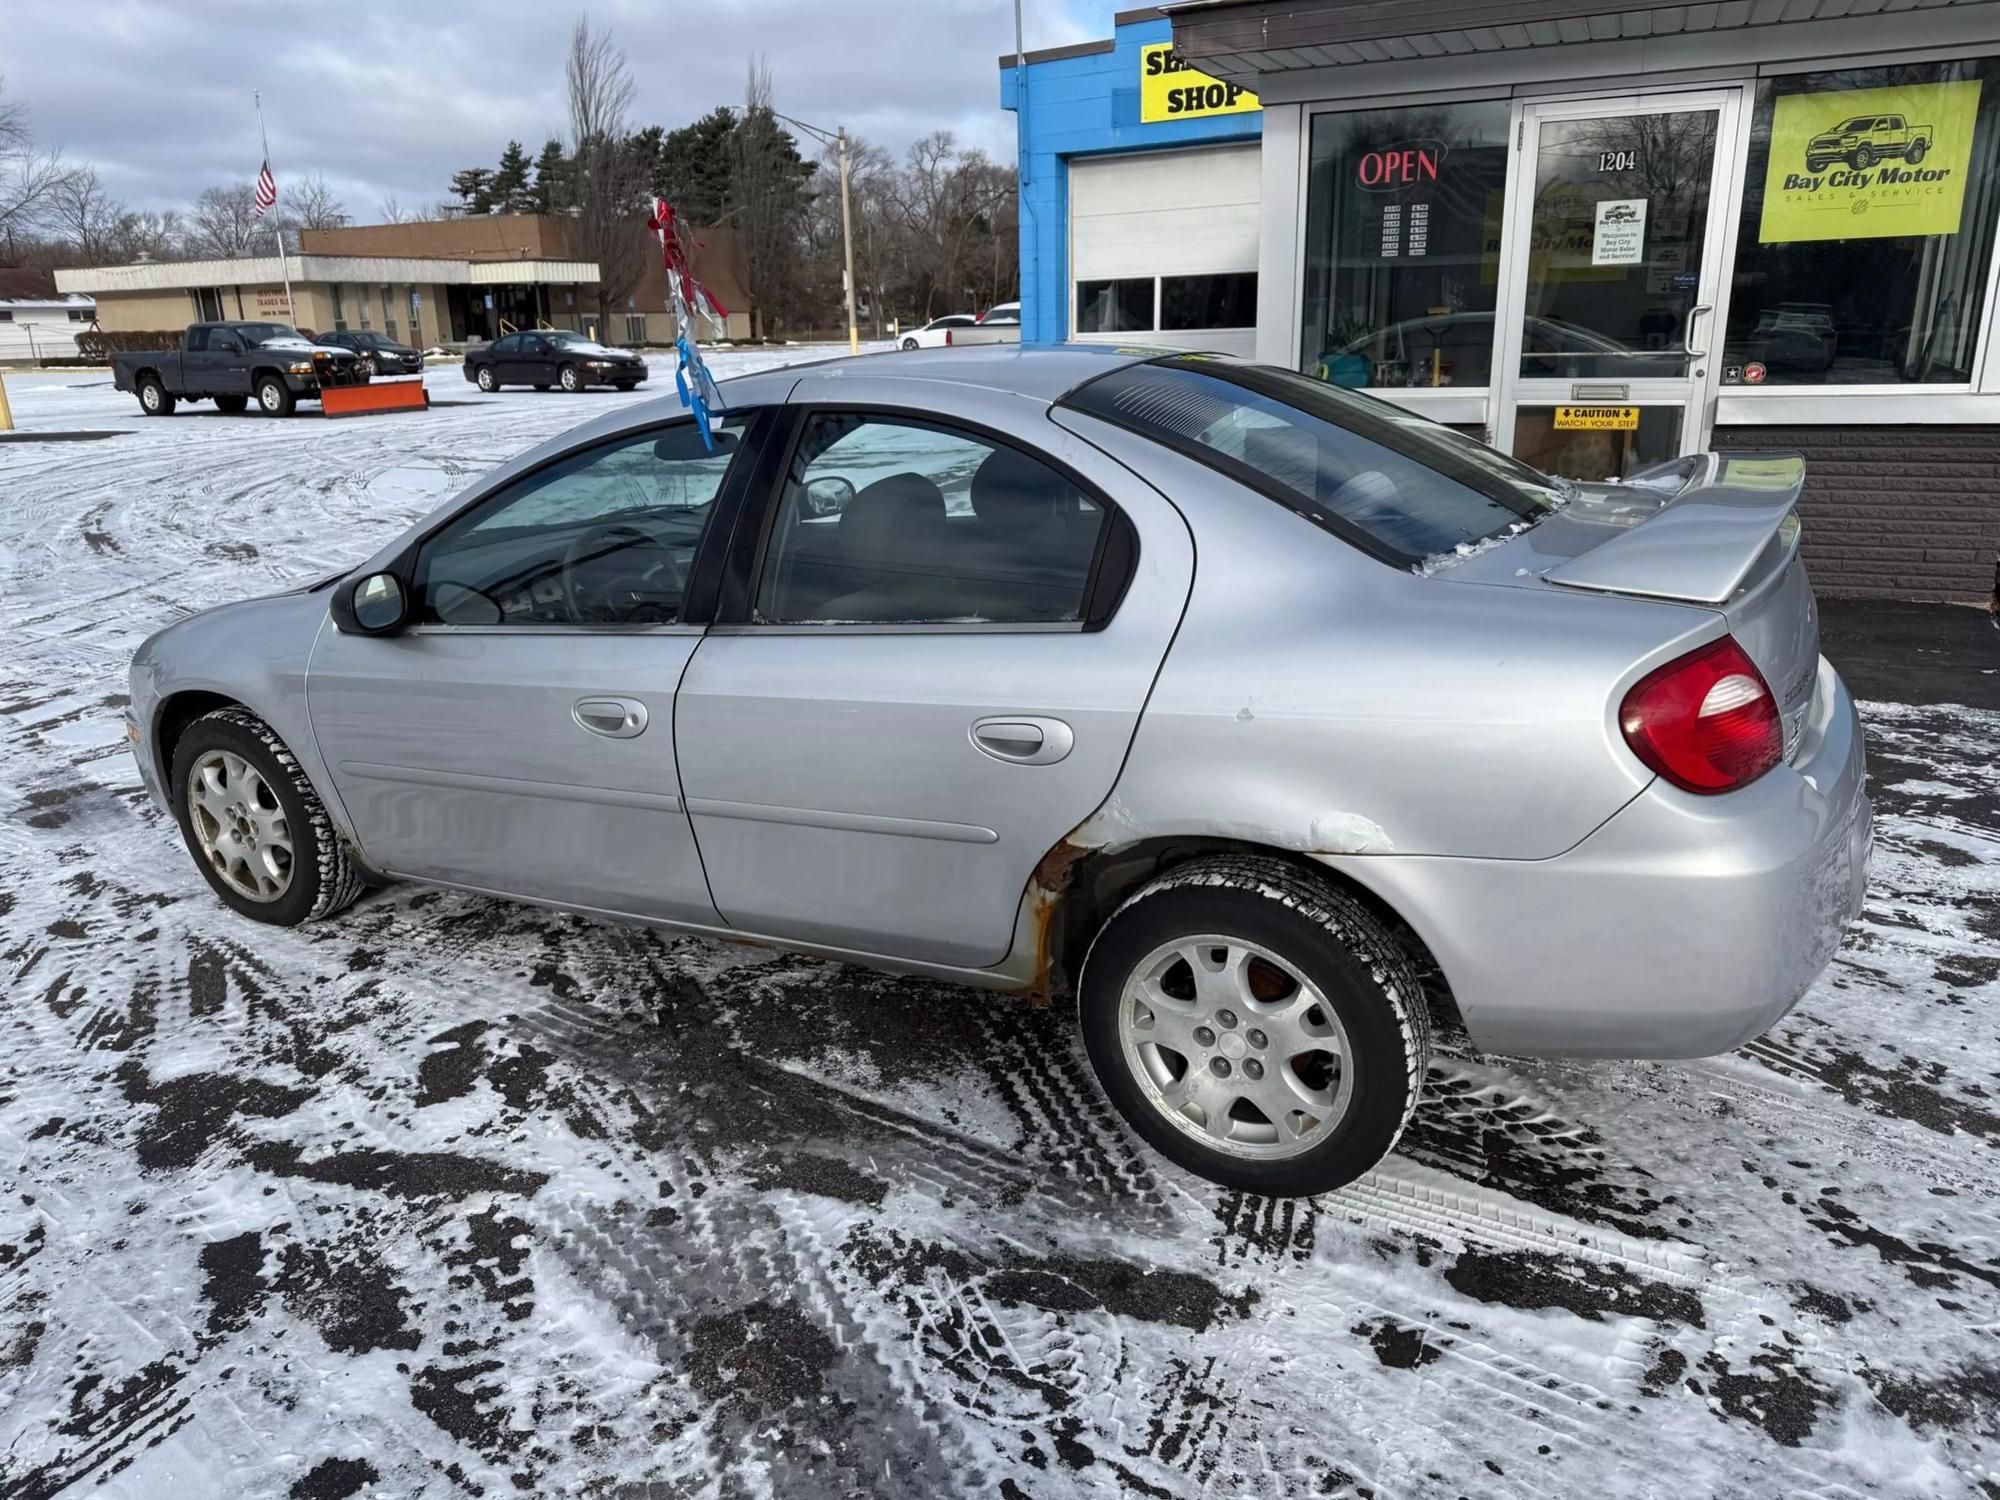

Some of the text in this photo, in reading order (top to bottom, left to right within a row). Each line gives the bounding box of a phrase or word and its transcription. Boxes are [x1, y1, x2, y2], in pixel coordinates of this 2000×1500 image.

[1168, 83, 1243, 113] SHOP
[1359, 149, 1438, 185] OPEN
[1599, 151, 1636, 171] 1204
[1783, 167, 1951, 192] Bay City Motor
[1785, 193, 1835, 202] SALES
[1871, 187, 1944, 198] SERVICE
[1574, 409, 1621, 418] CAUTION
